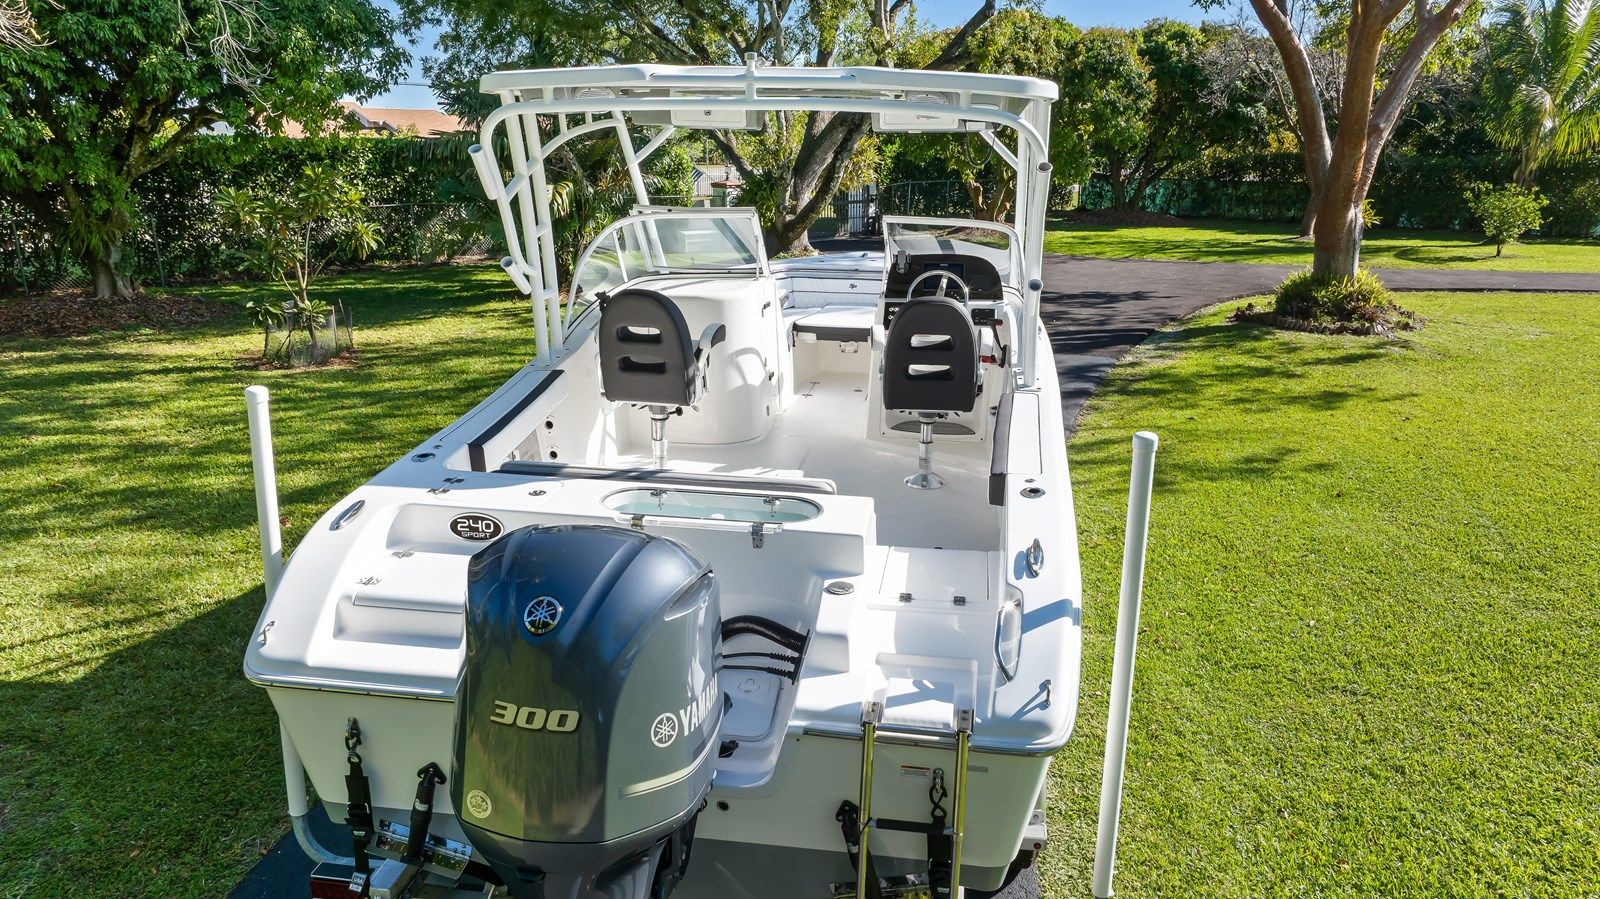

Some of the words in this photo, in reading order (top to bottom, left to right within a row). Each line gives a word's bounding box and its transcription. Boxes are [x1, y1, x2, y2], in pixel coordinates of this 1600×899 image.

[457, 518, 494, 532] 240
[461, 531, 491, 539] SPORT
[490, 700, 580, 731] 300
